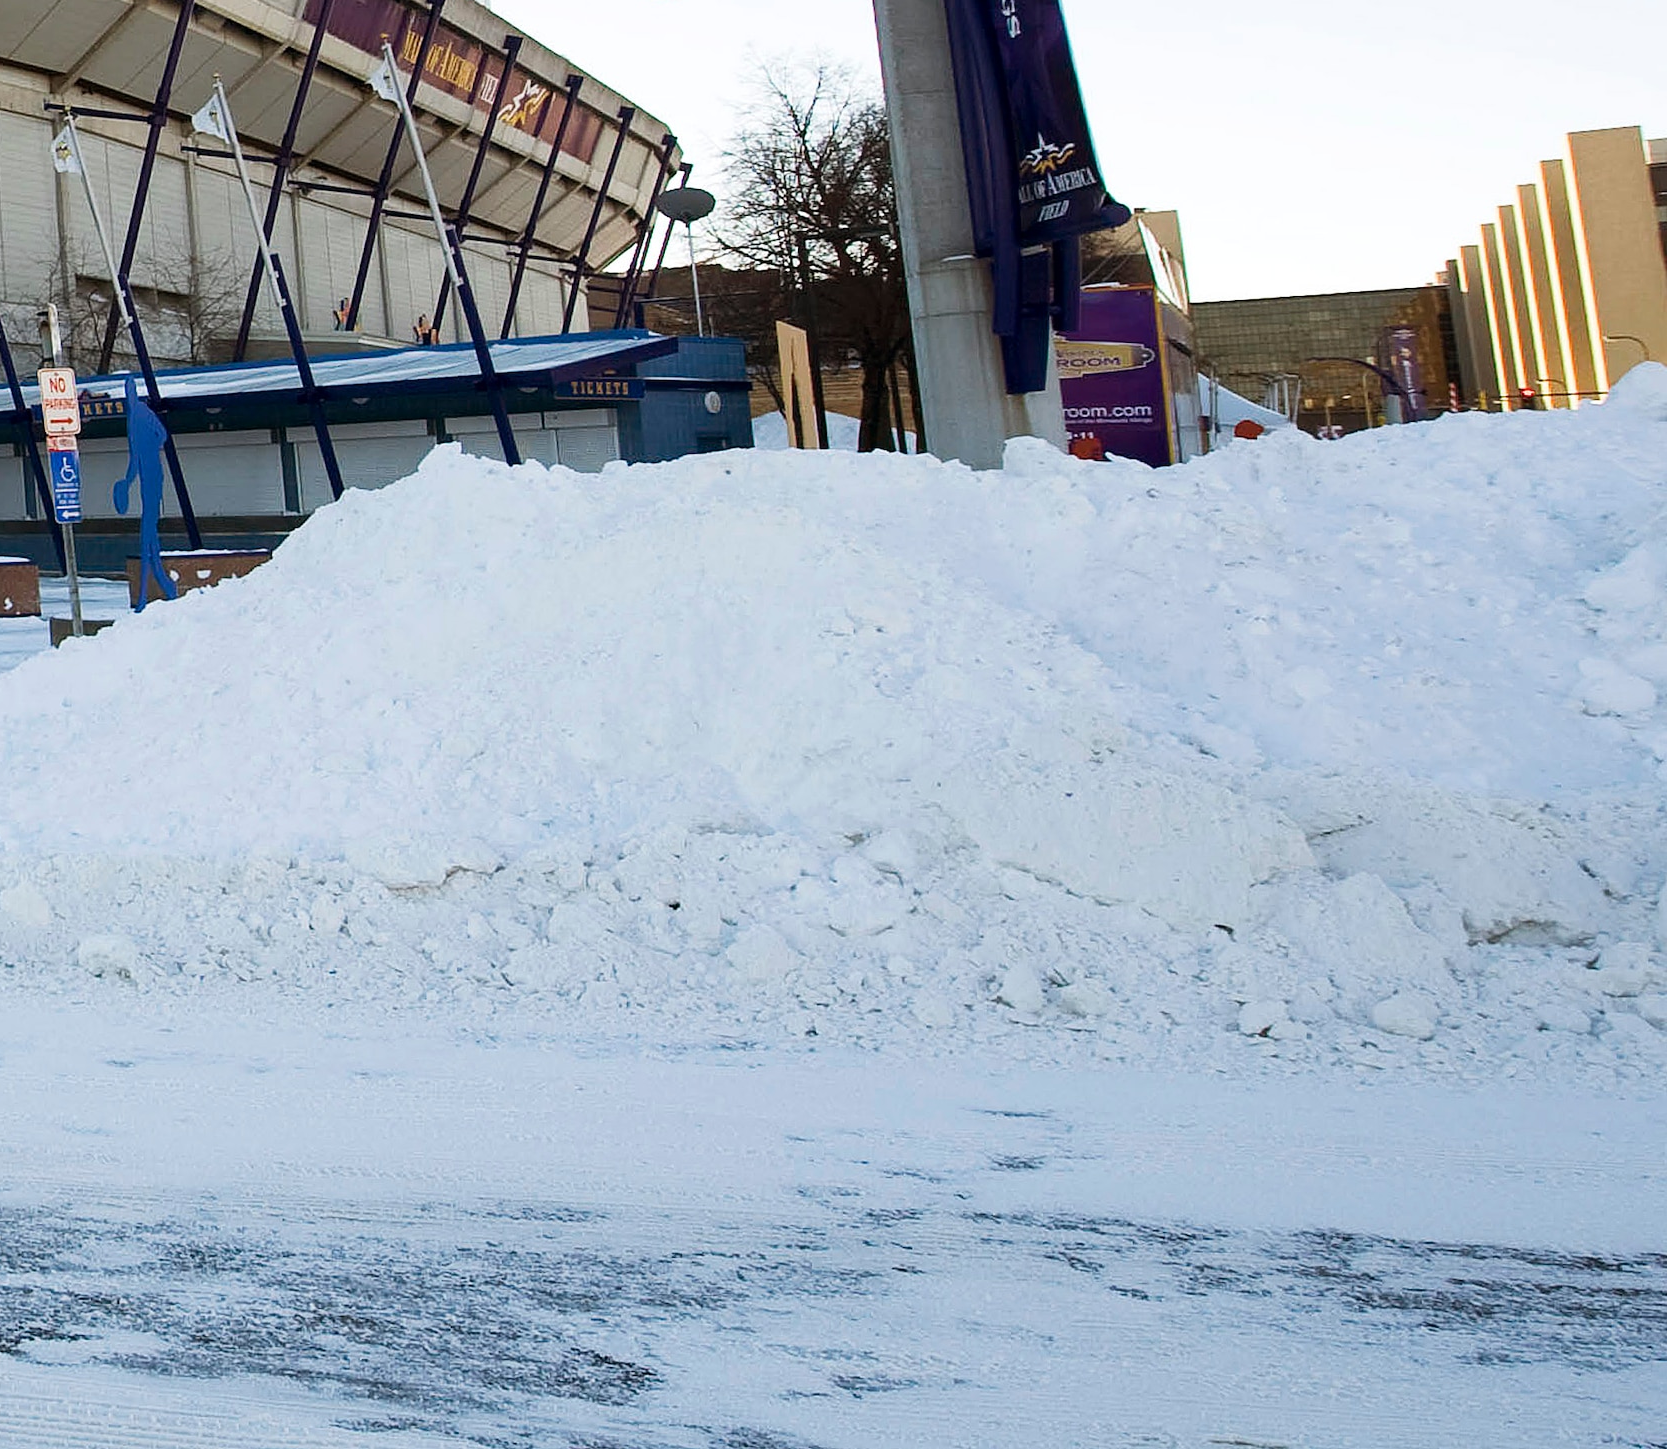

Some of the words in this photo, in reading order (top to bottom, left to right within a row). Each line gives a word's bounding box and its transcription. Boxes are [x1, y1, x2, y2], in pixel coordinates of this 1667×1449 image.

[1047, 165, 1098, 197] AMERICA
[49, 377, 66, 394] NO
[570, 381, 629, 395] TICKETS
[83, 402, 124, 416] KETS
[1063, 405, 1152, 418] room.com
